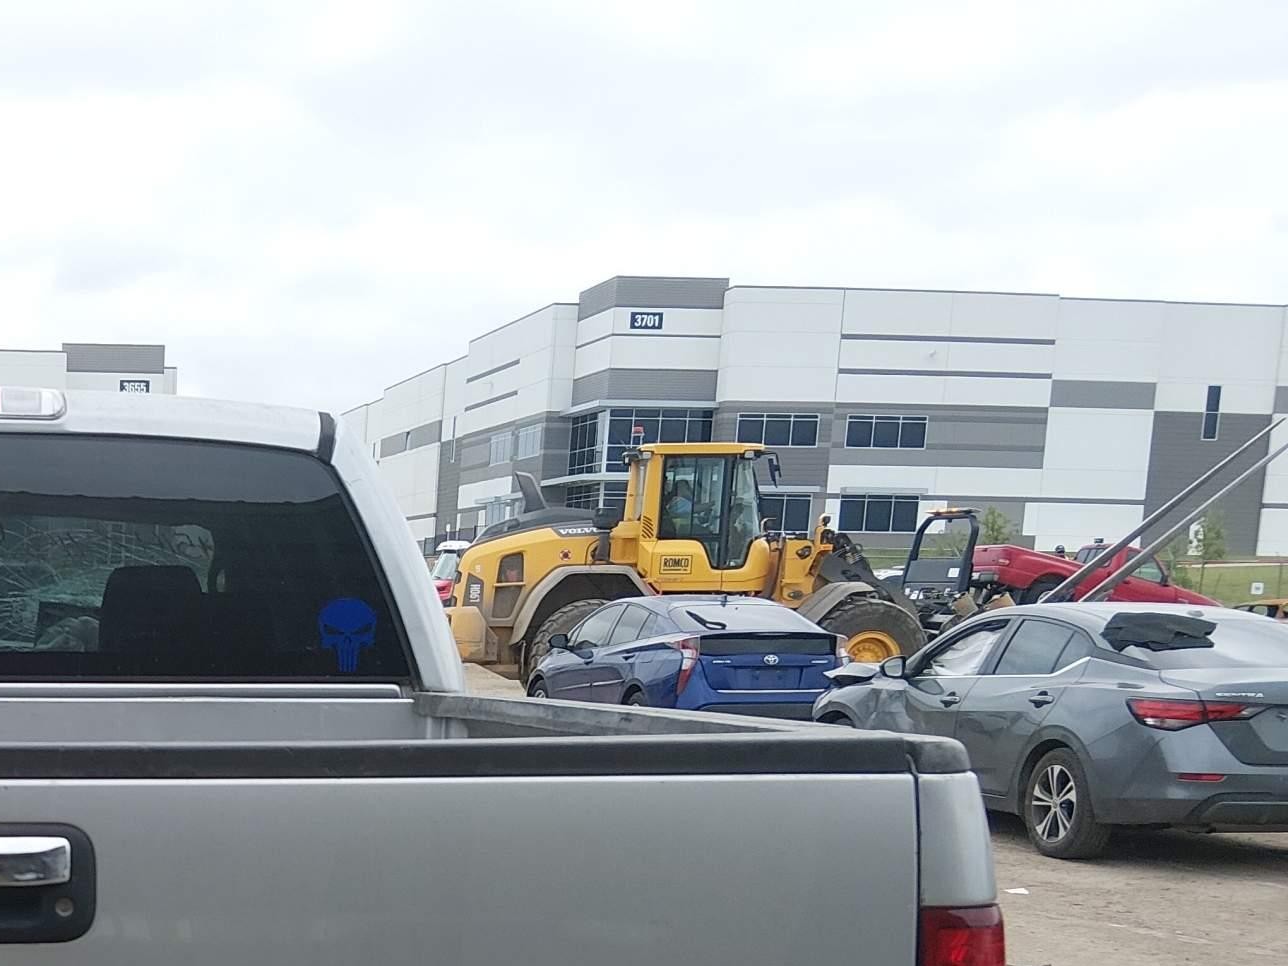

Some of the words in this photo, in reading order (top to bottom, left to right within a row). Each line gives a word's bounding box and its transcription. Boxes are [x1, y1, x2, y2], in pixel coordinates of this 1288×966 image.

[634, 314, 660, 327] 3701
[123, 382, 147, 394] 3655
[663, 557, 689, 568] ROMCO
